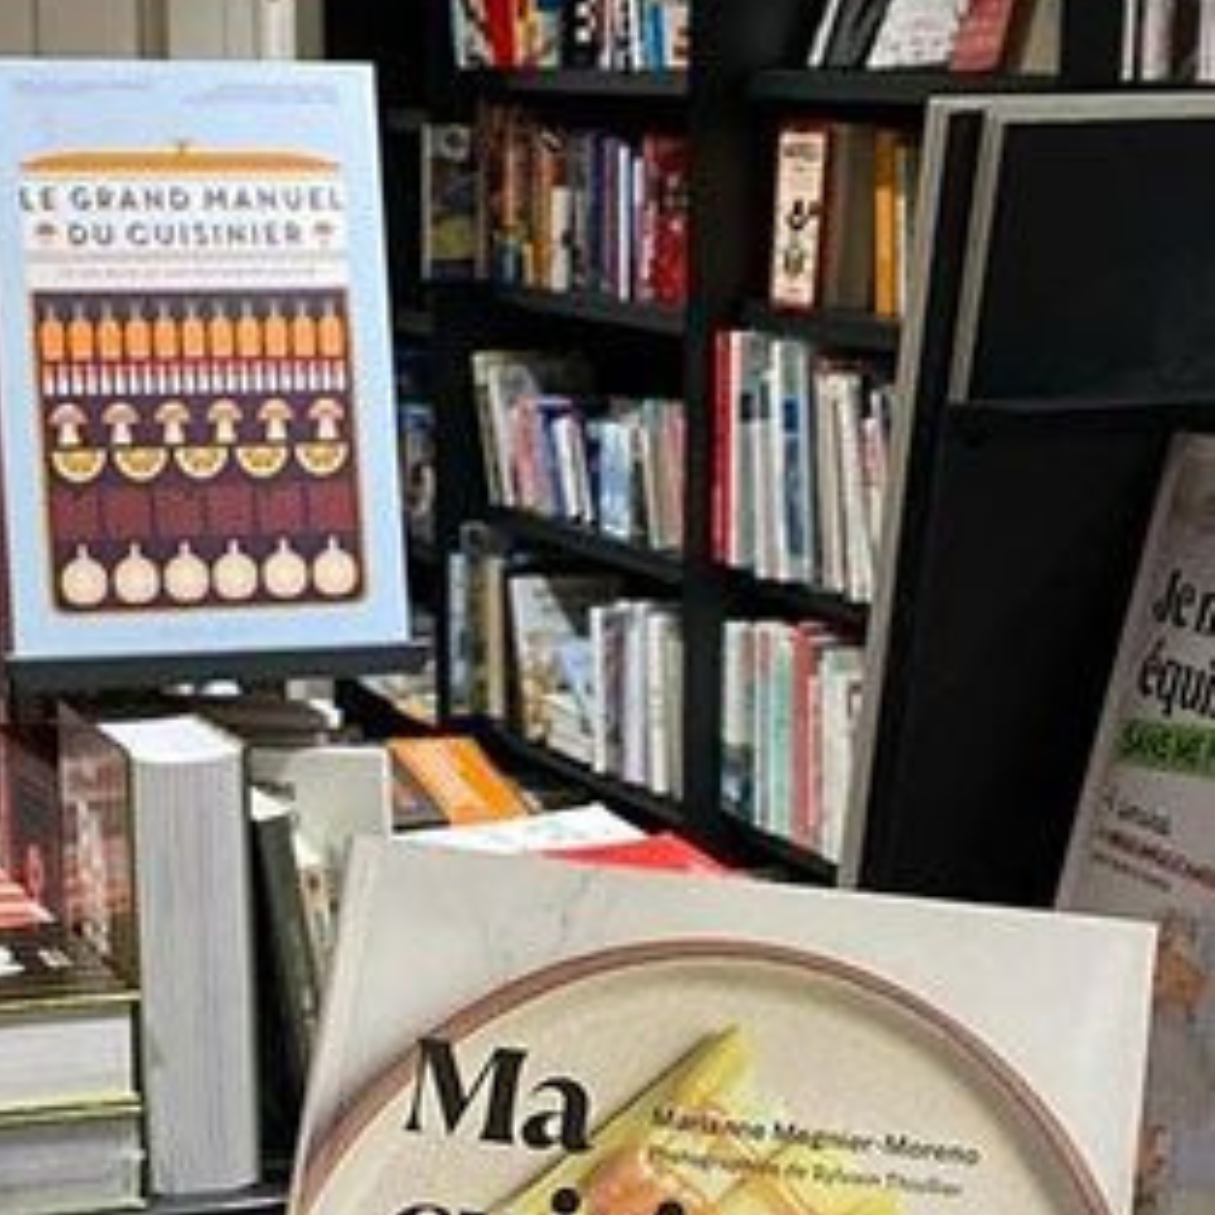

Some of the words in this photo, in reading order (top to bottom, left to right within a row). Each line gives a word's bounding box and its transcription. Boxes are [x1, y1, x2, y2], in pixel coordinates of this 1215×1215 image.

[17, 185, 57, 212] LE
[69, 184, 191, 211] GRAND
[203, 184, 347, 212] MANUEL
[67, 221, 115, 246] DU
[125, 220, 304, 246] CUISINIER
[405, 1036, 593, 1154] Ma
